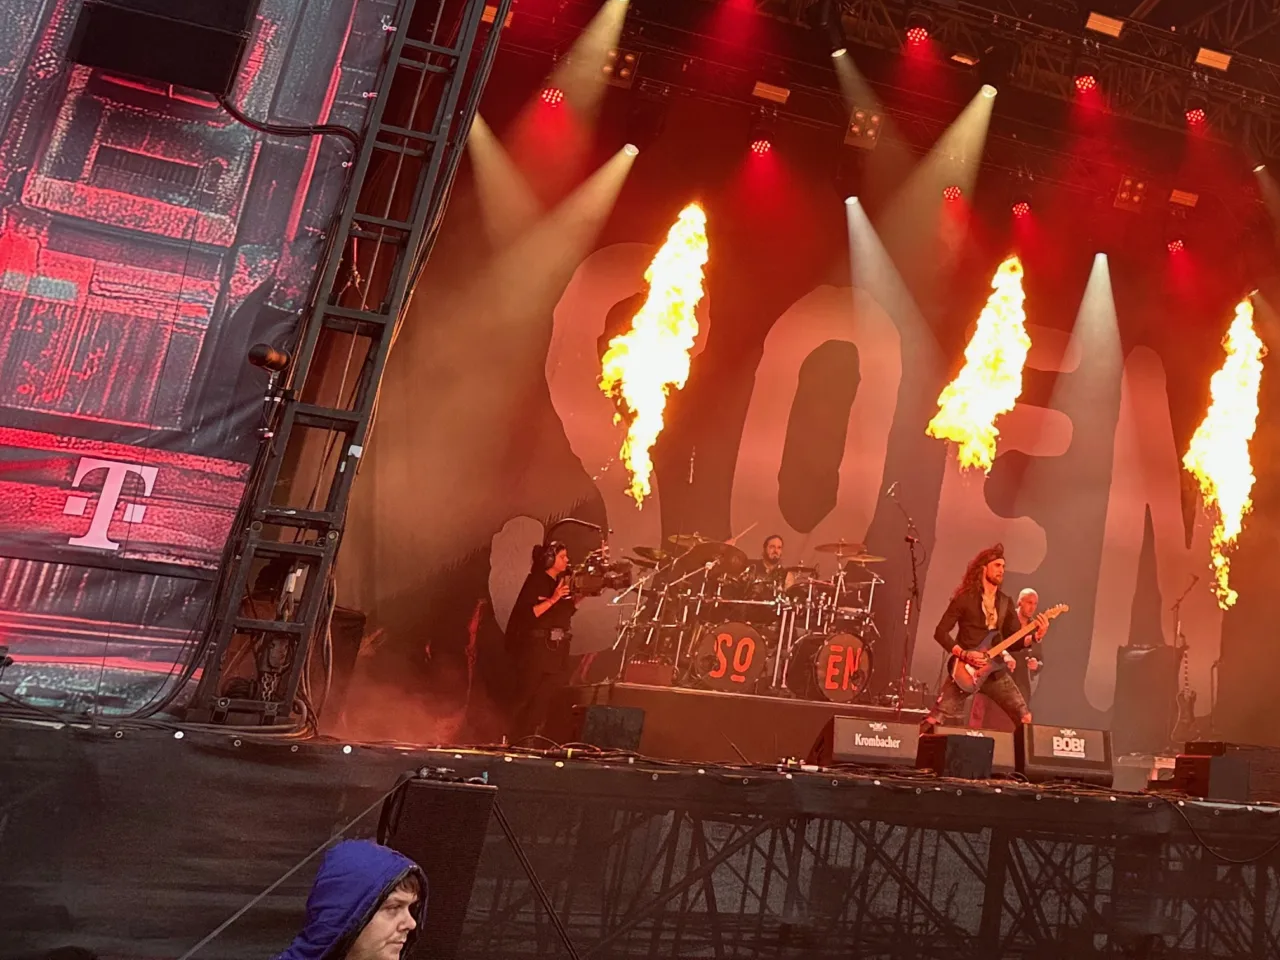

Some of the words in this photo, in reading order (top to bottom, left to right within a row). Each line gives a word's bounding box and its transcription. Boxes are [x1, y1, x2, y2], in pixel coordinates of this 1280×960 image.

[63, 456, 159, 550] T
[855, 733, 901, 748] Krombacher
[1052, 736, 1085, 752] BOB!
